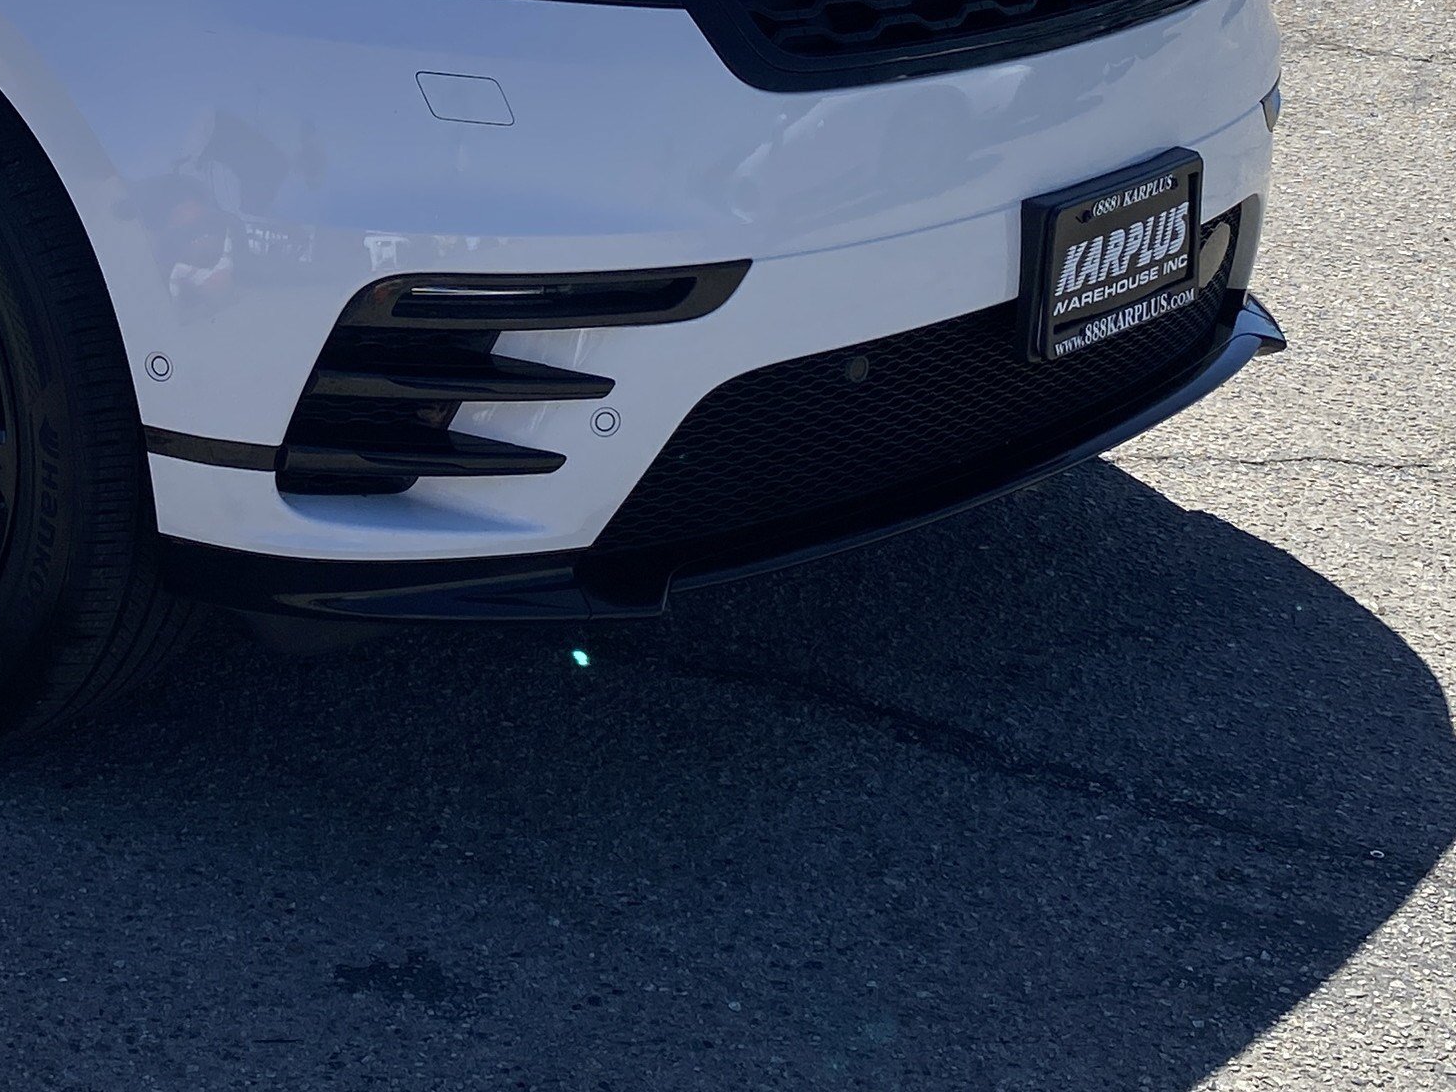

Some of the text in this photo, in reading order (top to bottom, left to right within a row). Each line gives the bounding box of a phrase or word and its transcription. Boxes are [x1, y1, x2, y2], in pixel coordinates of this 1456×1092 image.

[1093, 174, 1173, 218] (888) KARPLUS
[1054, 201, 1189, 297] KARPLUS
[1053, 255, 1189, 317] WAREHOUSE INC
